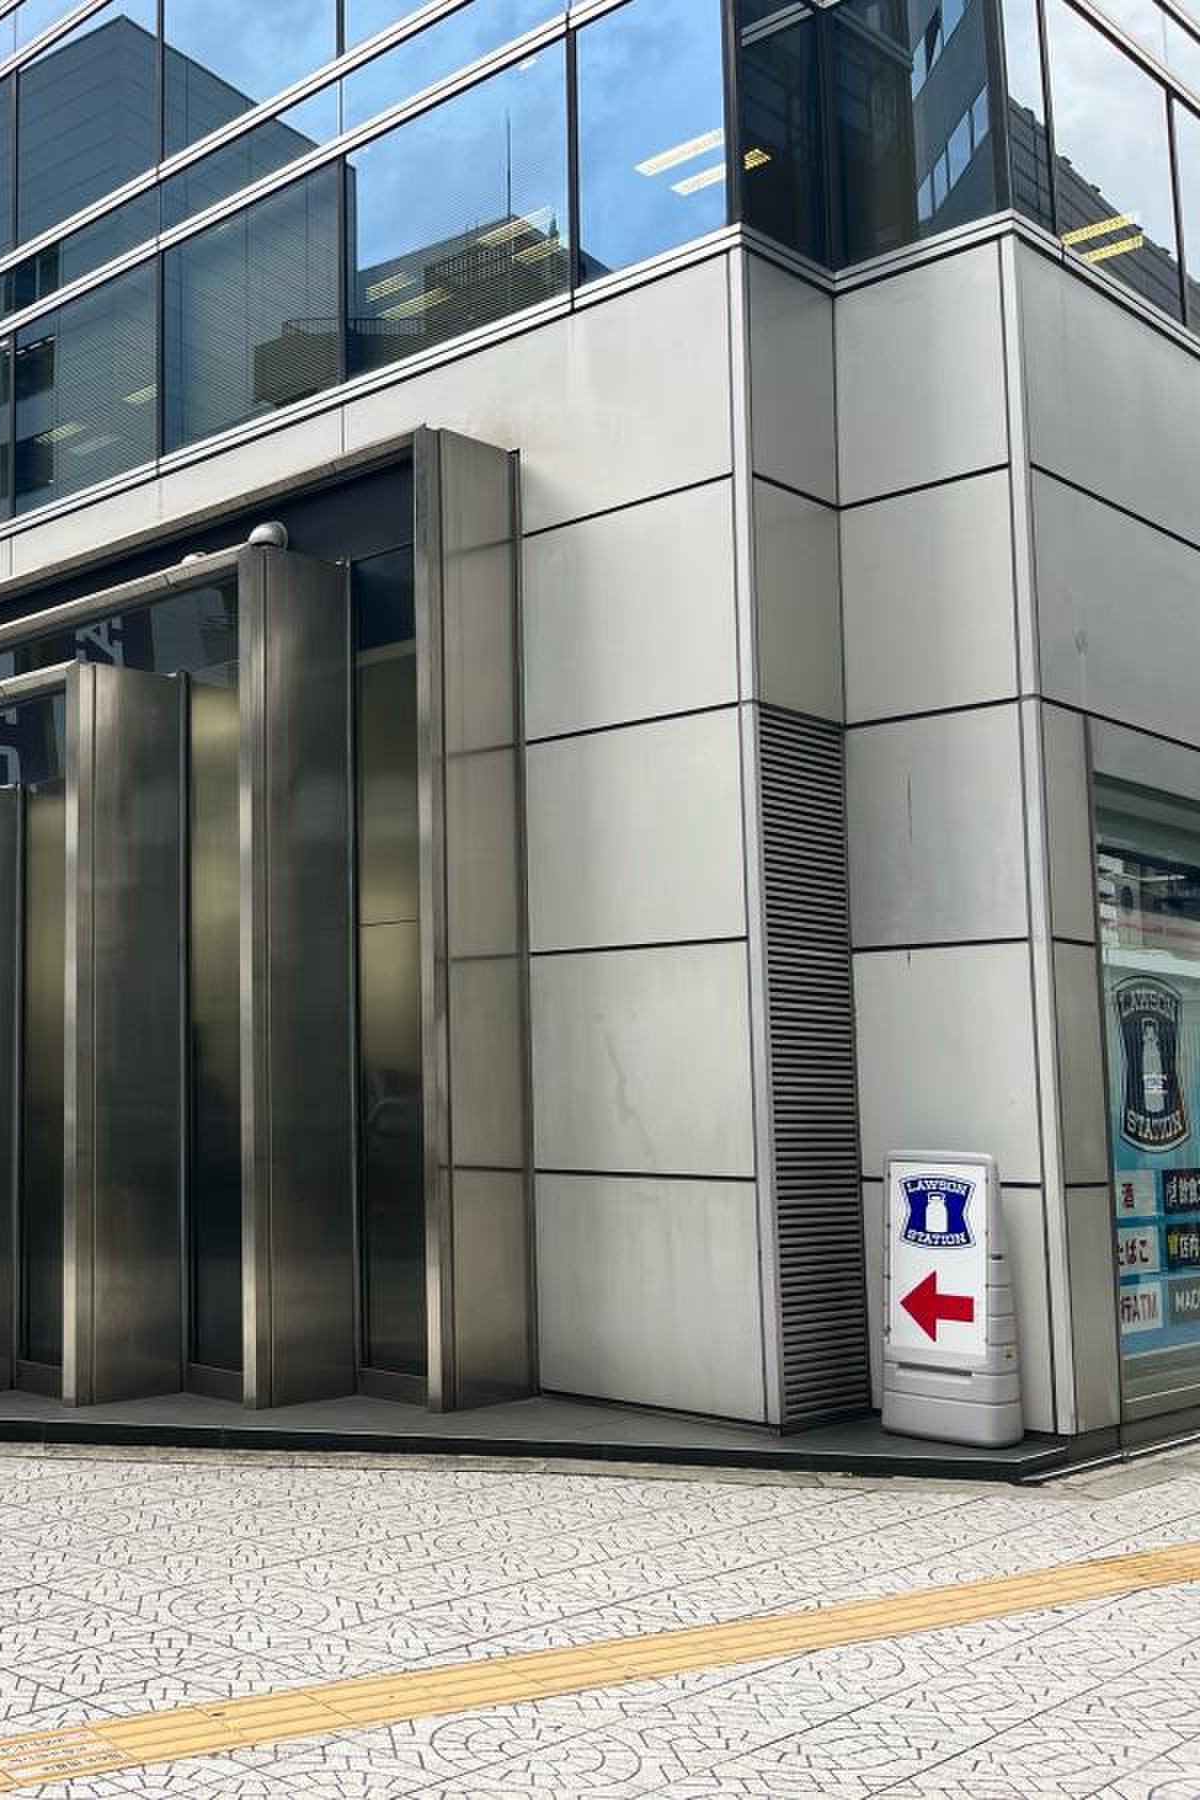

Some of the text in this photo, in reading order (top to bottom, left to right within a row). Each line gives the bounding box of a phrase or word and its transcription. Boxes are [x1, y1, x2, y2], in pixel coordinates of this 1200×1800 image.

[1126, 1109, 1183, 1141] STATION
[906, 1180, 966, 1197] LAWSON
[906, 1229, 967, 1244] STATION
